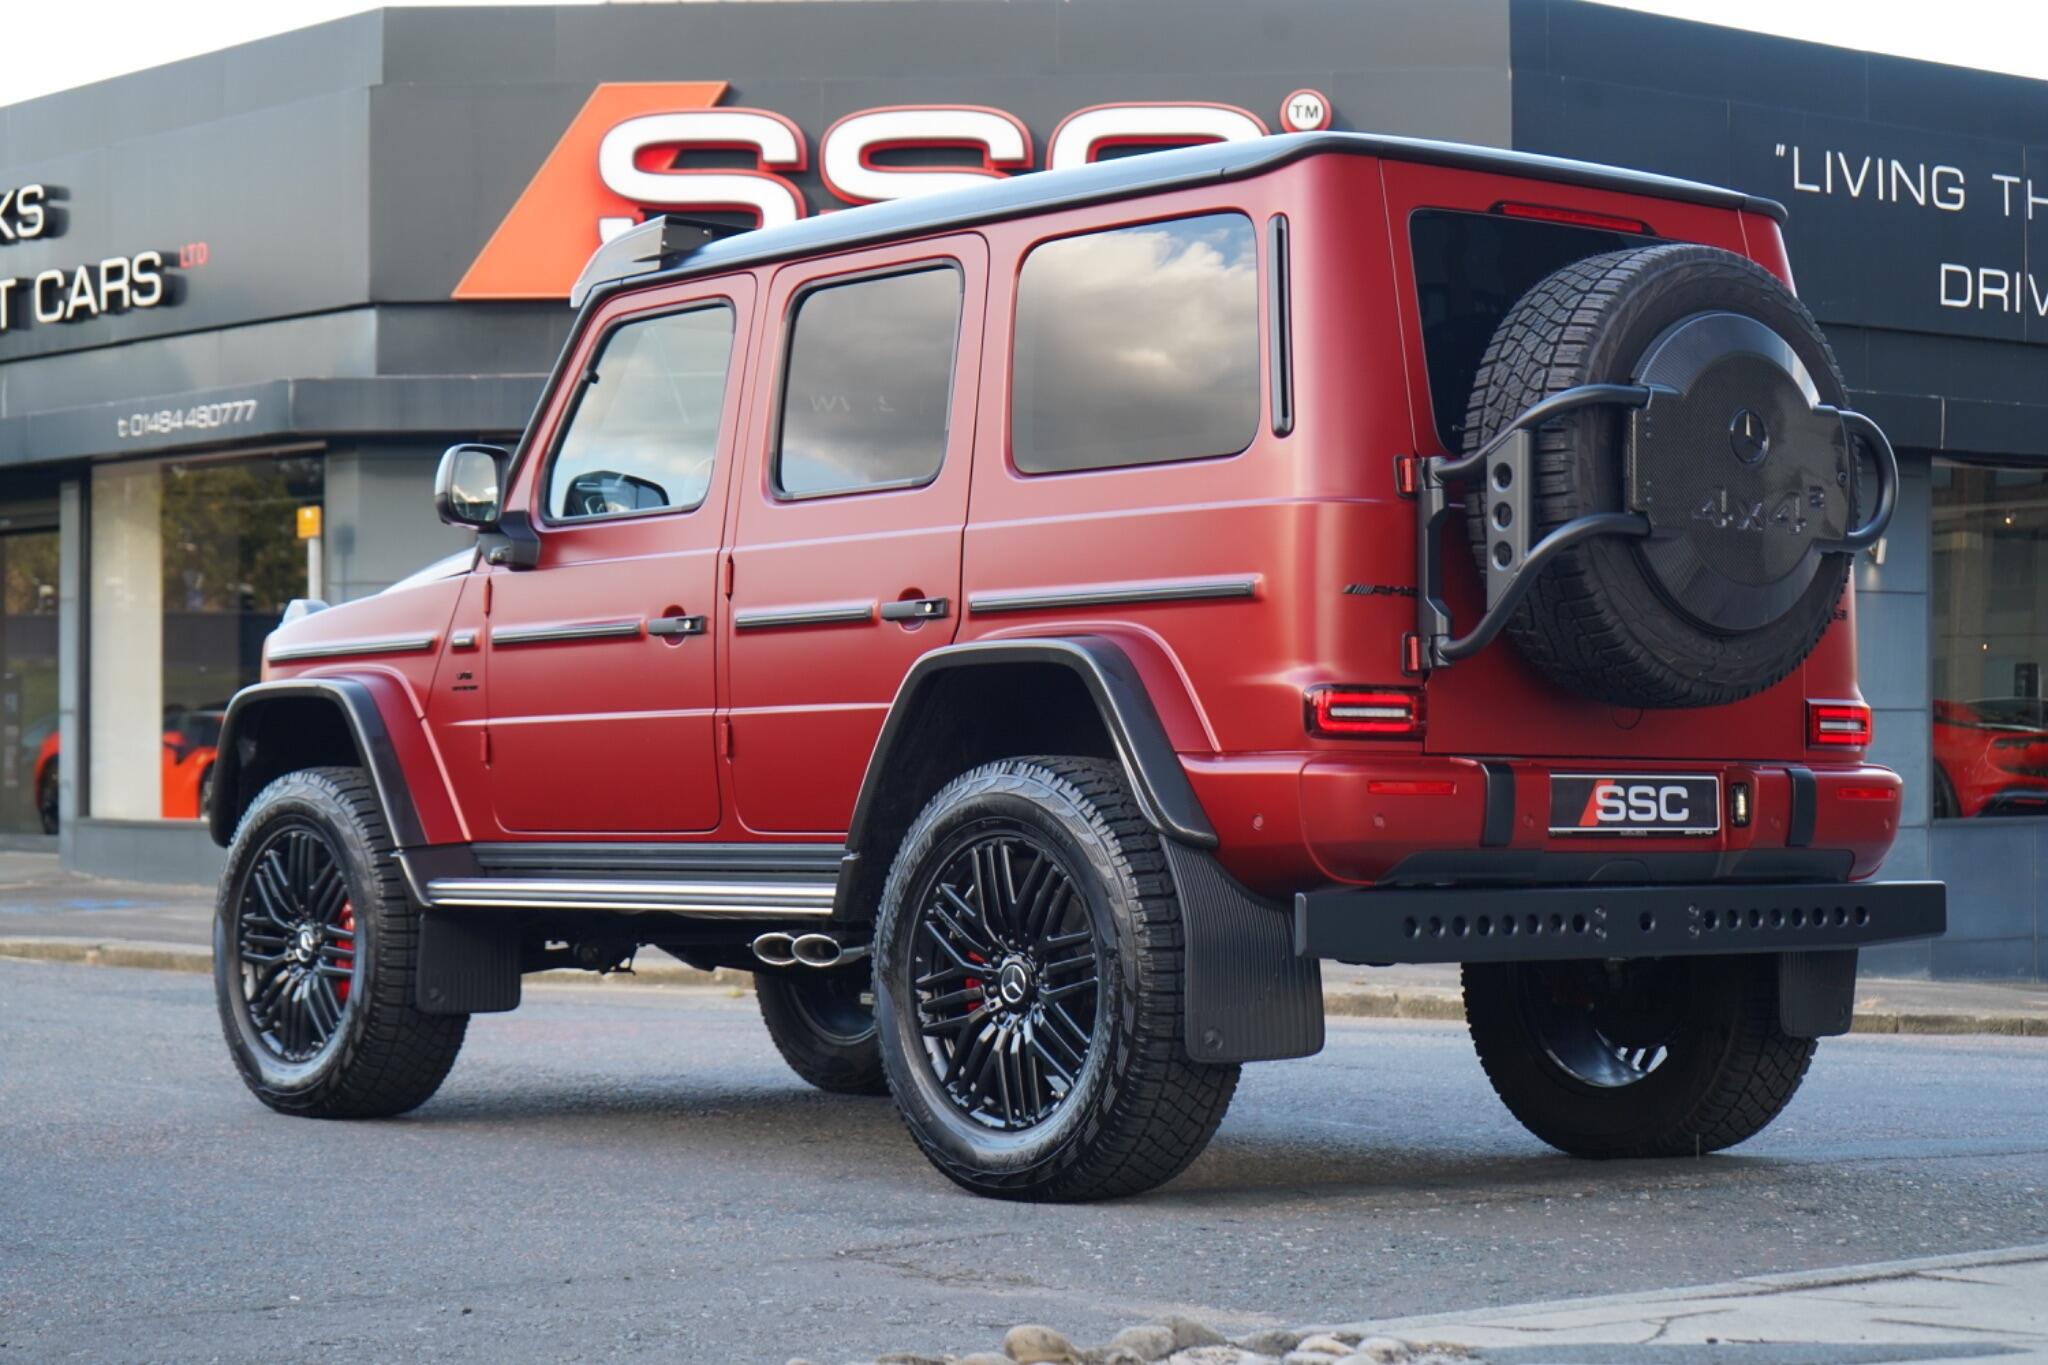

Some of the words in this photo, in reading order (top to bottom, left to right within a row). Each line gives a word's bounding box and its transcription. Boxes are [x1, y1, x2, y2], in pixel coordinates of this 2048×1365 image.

[1293, 104, 1319, 119] TM
[597, 103, 1268, 246] SS
[179, 242, 208, 269] LTD
[34, 251, 163, 323] CARS
[1595, 785, 1690, 822] SSC
